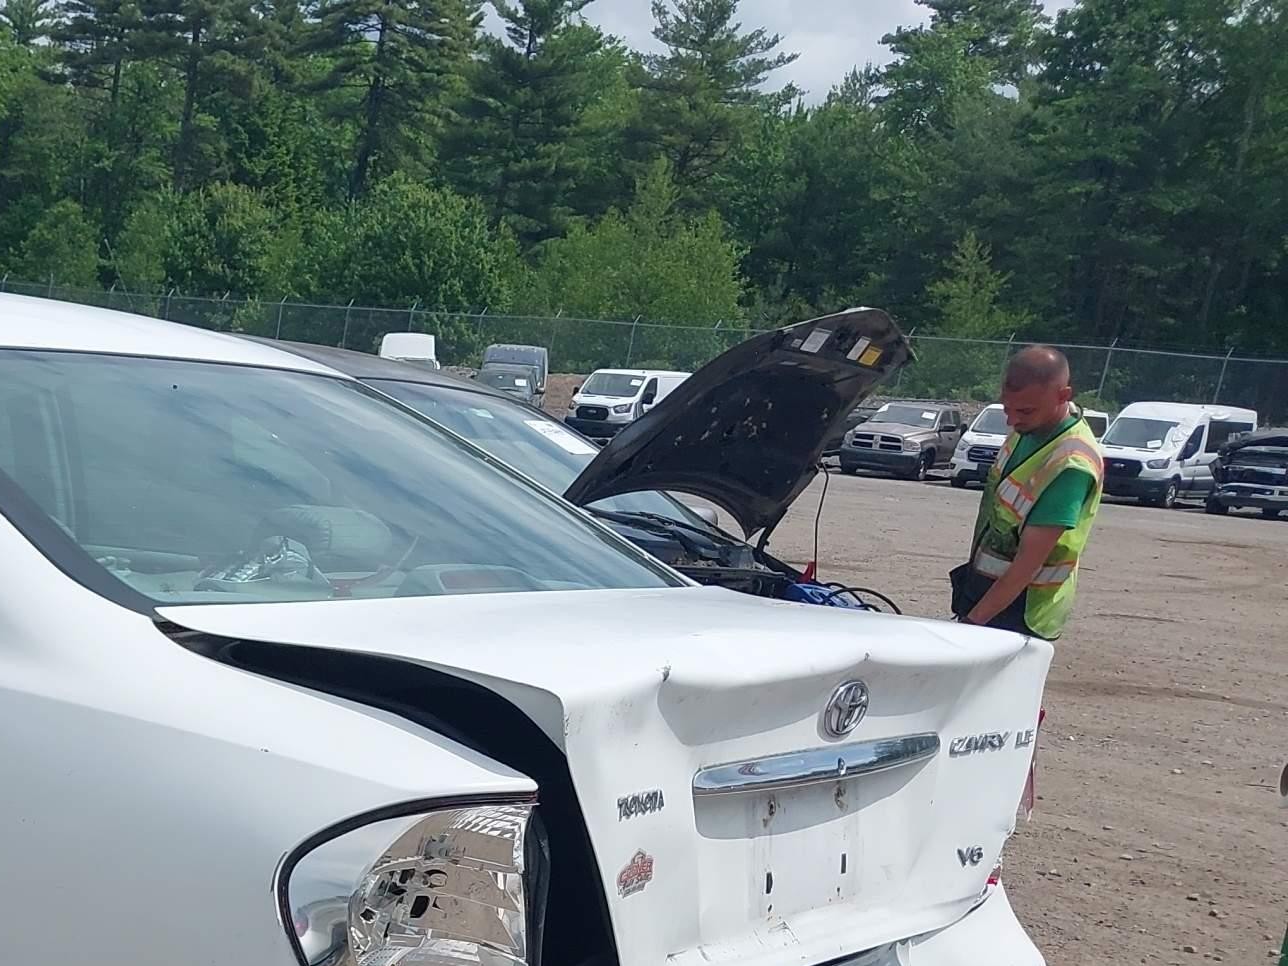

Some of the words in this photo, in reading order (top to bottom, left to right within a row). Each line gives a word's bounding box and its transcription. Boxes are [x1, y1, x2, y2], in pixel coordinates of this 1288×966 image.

[1015, 729, 1034, 749] LE
[617, 790, 664, 822] TOYOTA
[957, 846, 983, 868] V6
